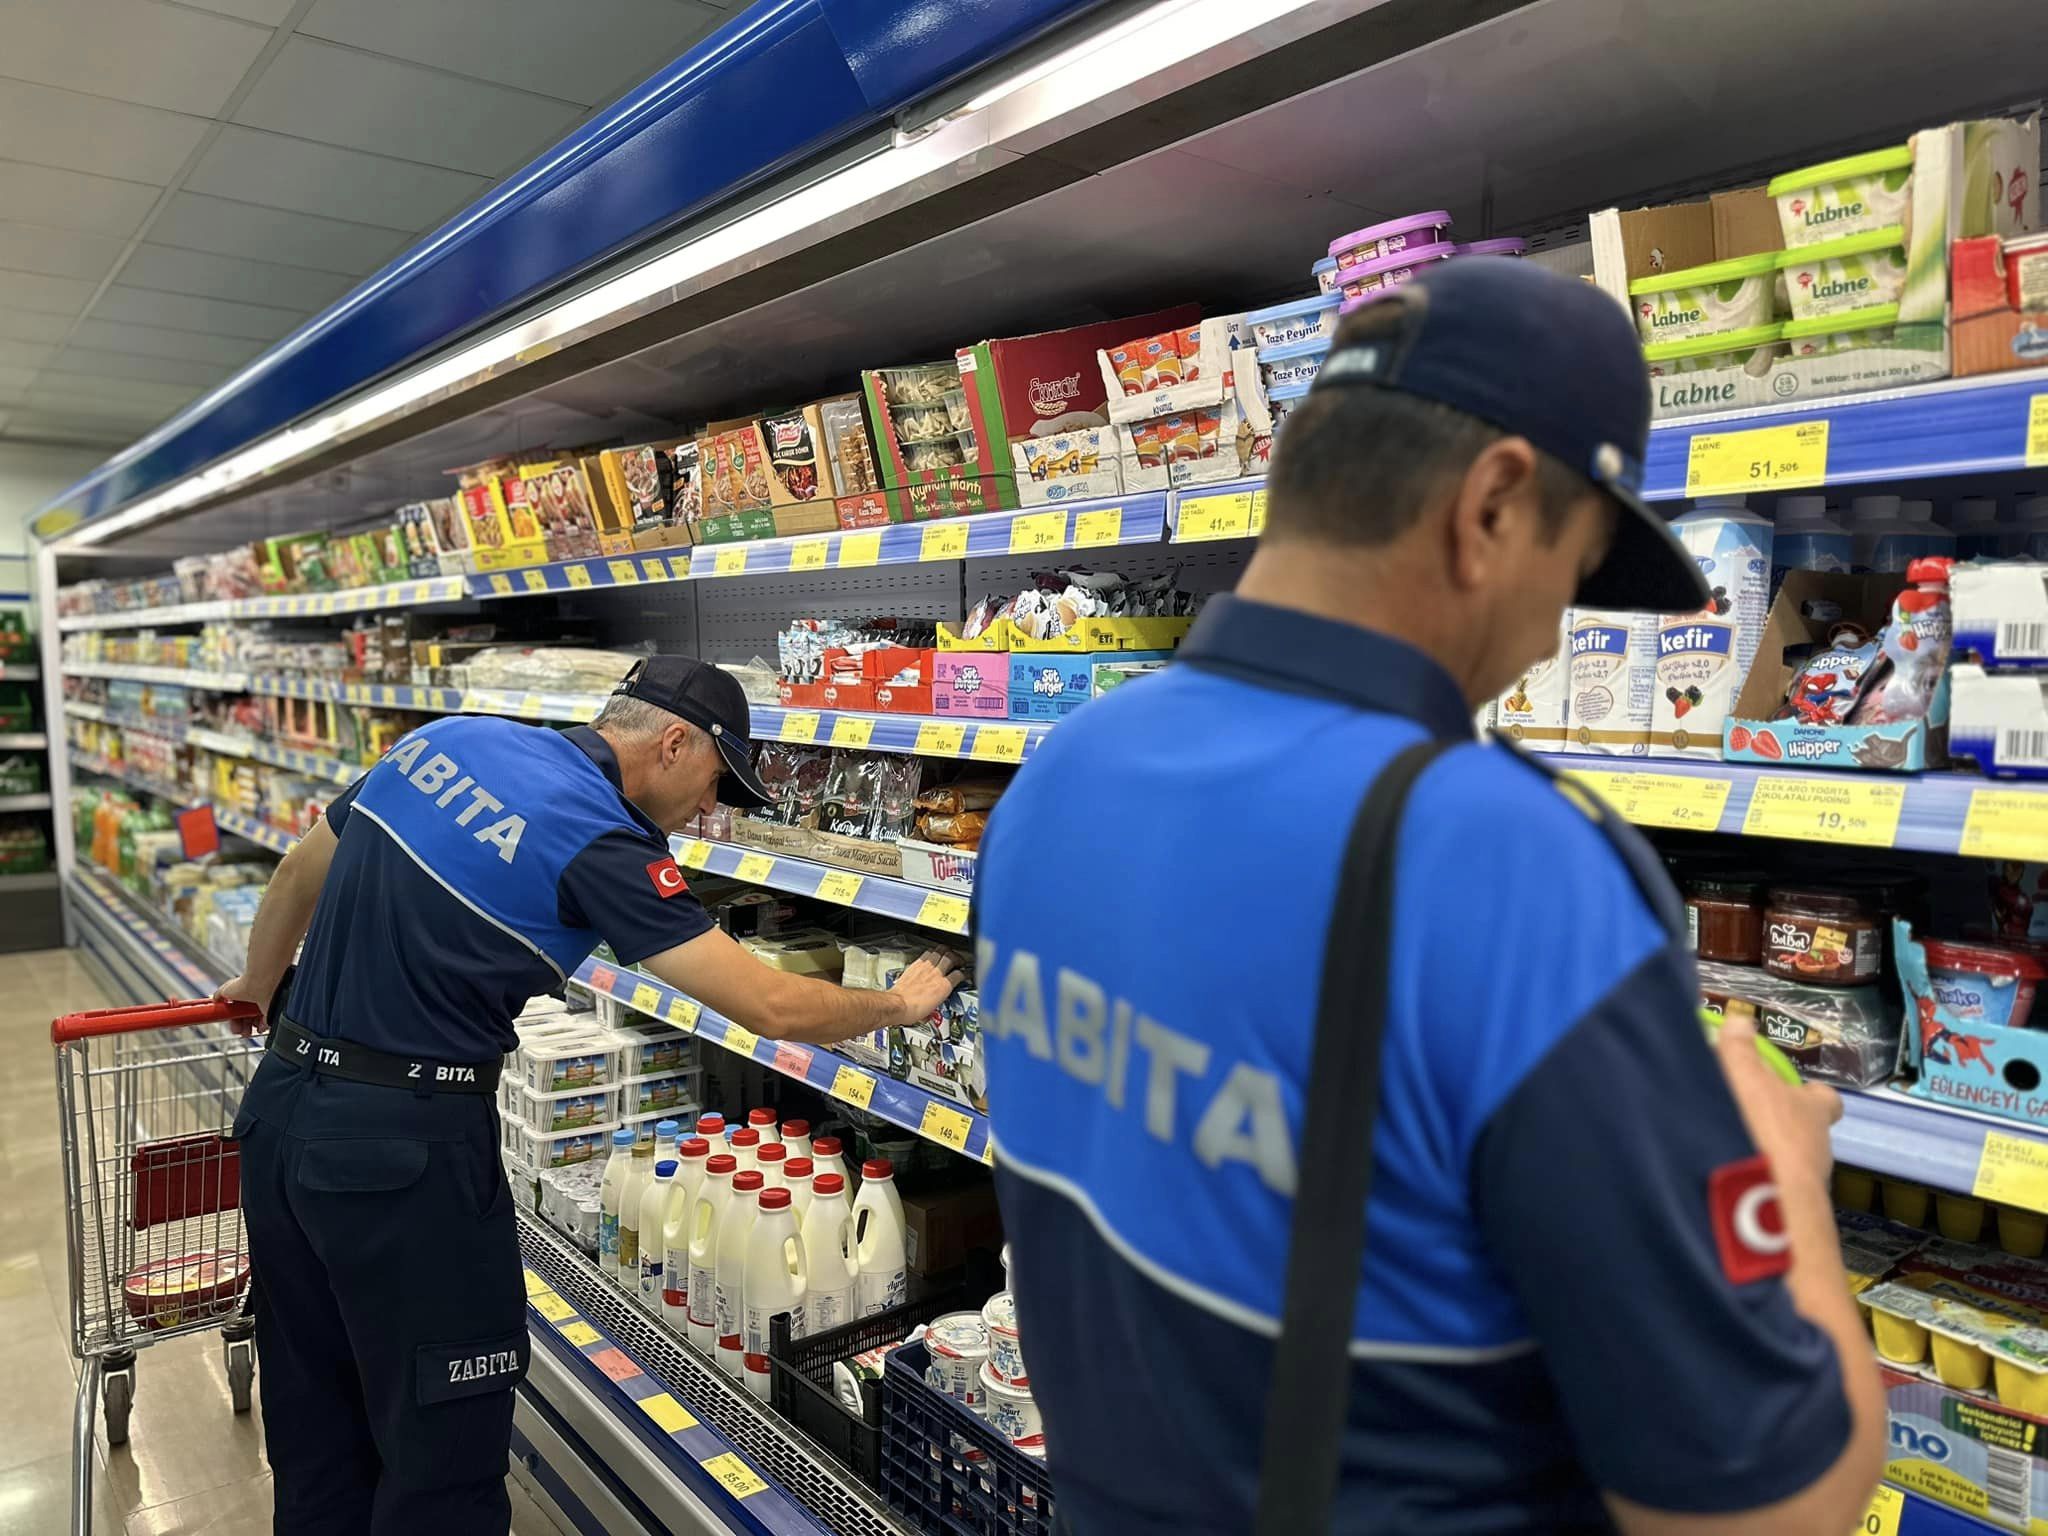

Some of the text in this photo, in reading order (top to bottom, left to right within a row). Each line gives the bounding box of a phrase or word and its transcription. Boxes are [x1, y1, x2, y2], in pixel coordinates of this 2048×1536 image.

[1804, 202, 1863, 226] Labne
[1812, 276, 1869, 299] Labne
[1652, 308, 1701, 327] Labne
[1266, 328, 1285, 344] Taze
[1286, 322, 1322, 340] Peynir
[1273, 362, 1321, 381] Taze Peyn
[1659, 381, 1736, 408] Labne
[1692, 442, 1721, 452] LABNE
[1572, 630, 1610, 654] kefir
[1661, 628, 1713, 653] kefir
[1812, 655, 1860, 668] üpper
[962, 667, 978, 680] Süt
[1042, 669, 1060, 683] Süt
[954, 678, 982, 693] Burger
[1033, 682, 1065, 697] Burger
[1788, 740, 1841, 757] Hüpper
[384, 733, 527, 864] ABITA
[850, 848, 877, 867] Mangal
[877, 853, 898, 866] Sucuk
[1937, 987, 1982, 1007] hake
[296, 1038, 340, 1066] ZITA
[408, 1063, 476, 1082] ZBITA
[1930, 1075, 2020, 1112] EĞLENCEYİ
[448, 1350, 519, 1383] ZABITA
